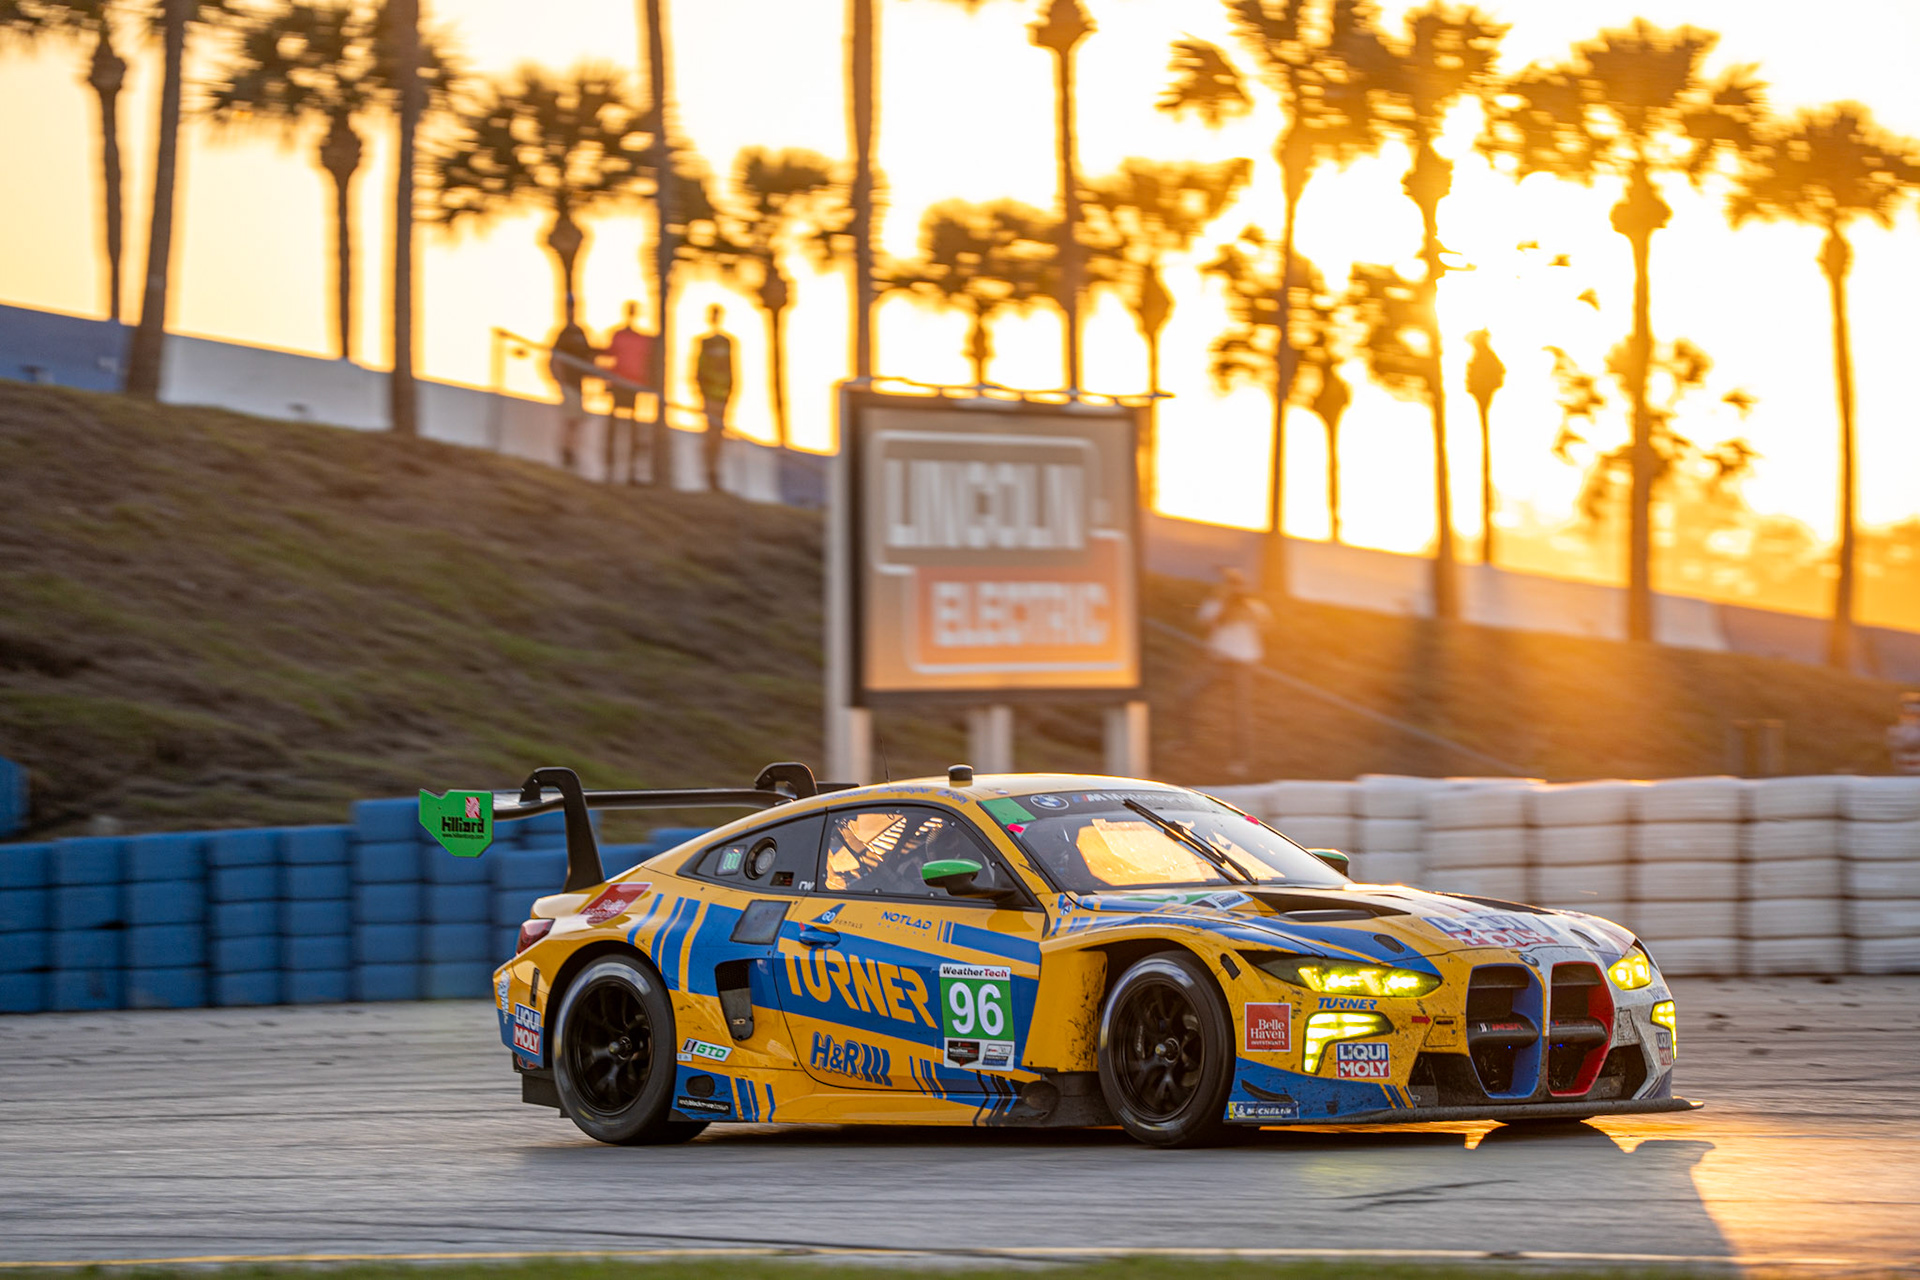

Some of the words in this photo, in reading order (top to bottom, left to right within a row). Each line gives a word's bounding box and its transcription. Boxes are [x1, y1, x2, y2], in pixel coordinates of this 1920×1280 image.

[884, 460, 1085, 551] LINCOLN
[931, 580, 1109, 648] ELECTRIC
[881, 910, 933, 930] NOTLAD
[1454, 929, 1548, 947] MOLY
[942, 966, 1008, 978] WeatherTech
[777, 936, 939, 1030] TURNER
[948, 981, 1005, 1036] 96
[1317, 997, 1378, 1010] TURNER
[515, 1003, 541, 1031] LIQUI
[1257, 1018, 1285, 1030] Belle
[514, 1025, 540, 1053] MOLY
[1250, 1028, 1285, 1040] Haven
[696, 1043, 727, 1058] GTD
[810, 1031, 863, 1080] H&R
[1339, 1044, 1387, 1061] LIQUI
[1339, 1061, 1388, 1077] MOLY
[1246, 1107, 1292, 1115] MICHELIN
